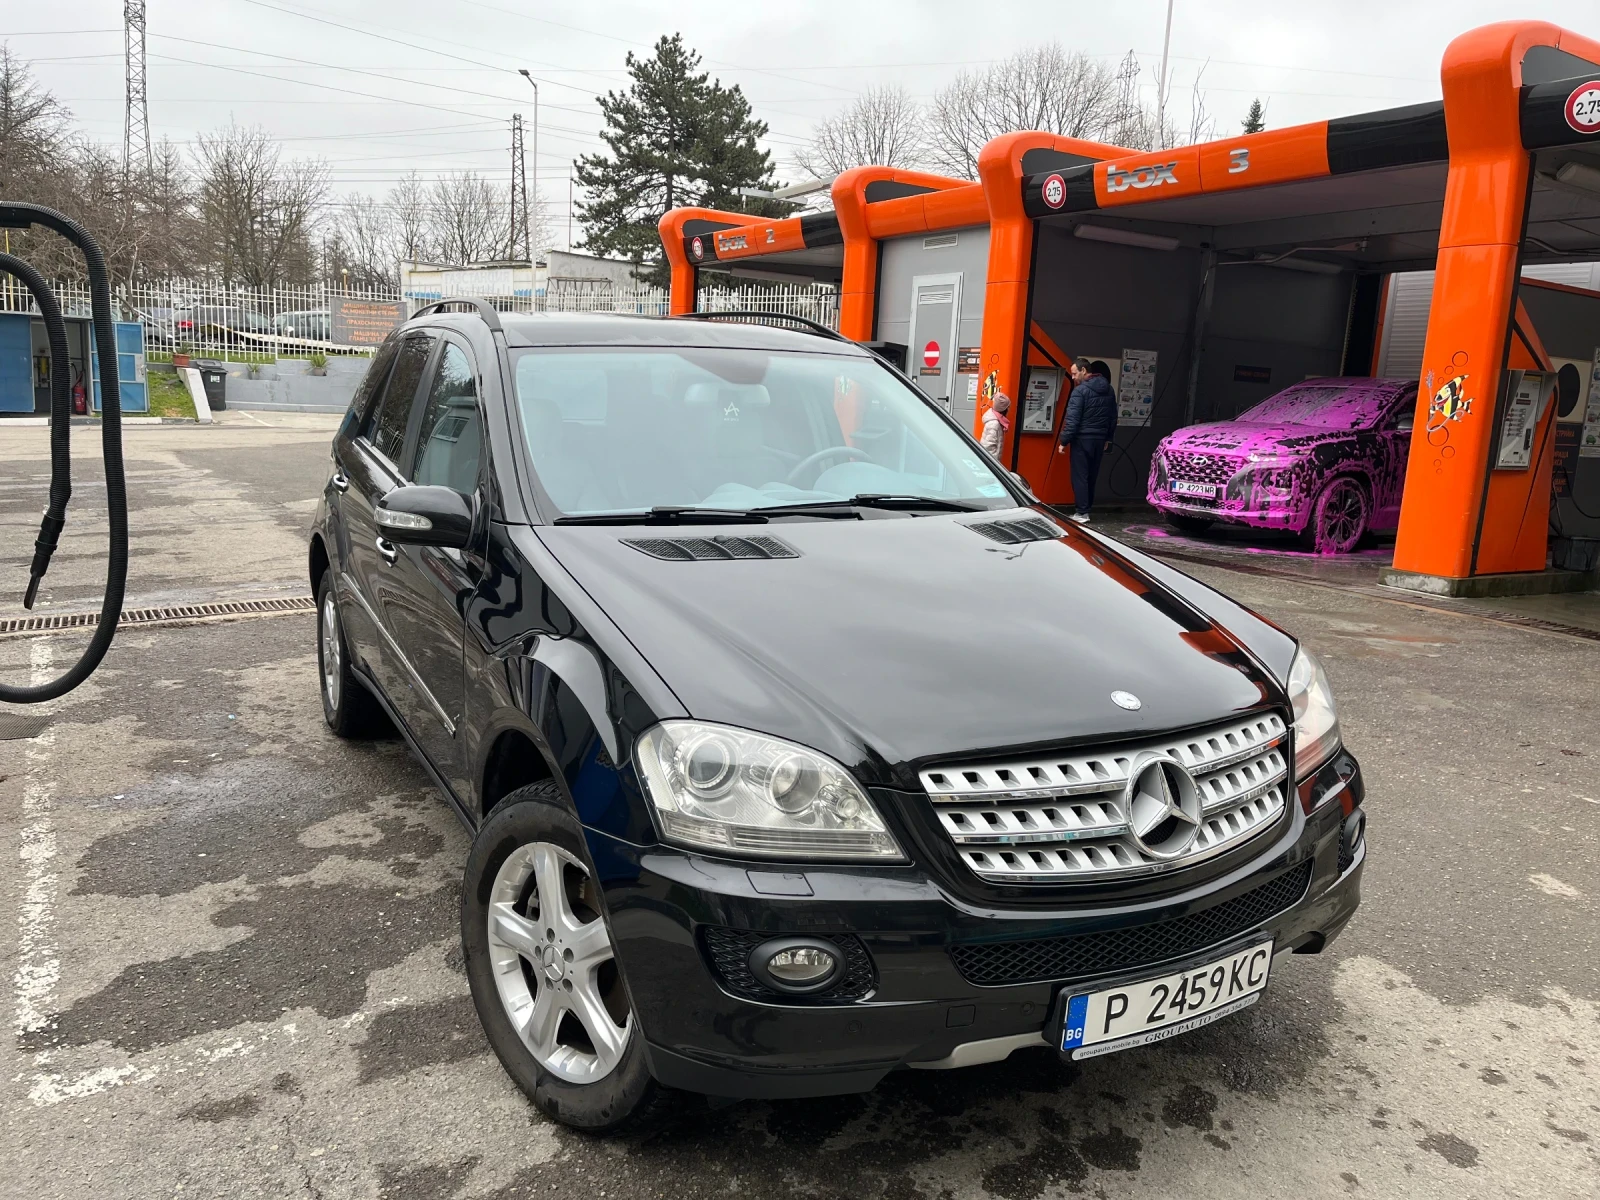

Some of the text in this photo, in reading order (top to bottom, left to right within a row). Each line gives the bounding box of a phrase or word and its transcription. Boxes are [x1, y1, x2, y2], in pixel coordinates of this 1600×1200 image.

[1107, 148, 1250, 193] box 3
[1047, 186, 1061, 198] 2.75
[718, 234, 749, 252] box
[765, 228, 775, 243] 2
[343, 302, 369, 310] МАШИНА
[346, 318, 394, 327] ПРАХОСМУКАЧКА
[1178, 482, 1184, 491] P
[1103, 993, 1129, 1034] P
[1066, 1027, 1083, 1041] BG
[1079, 1038, 1140, 1057] groupauto.mobile.bg
[1144, 1016, 1211, 1043] GROUPAUTO
